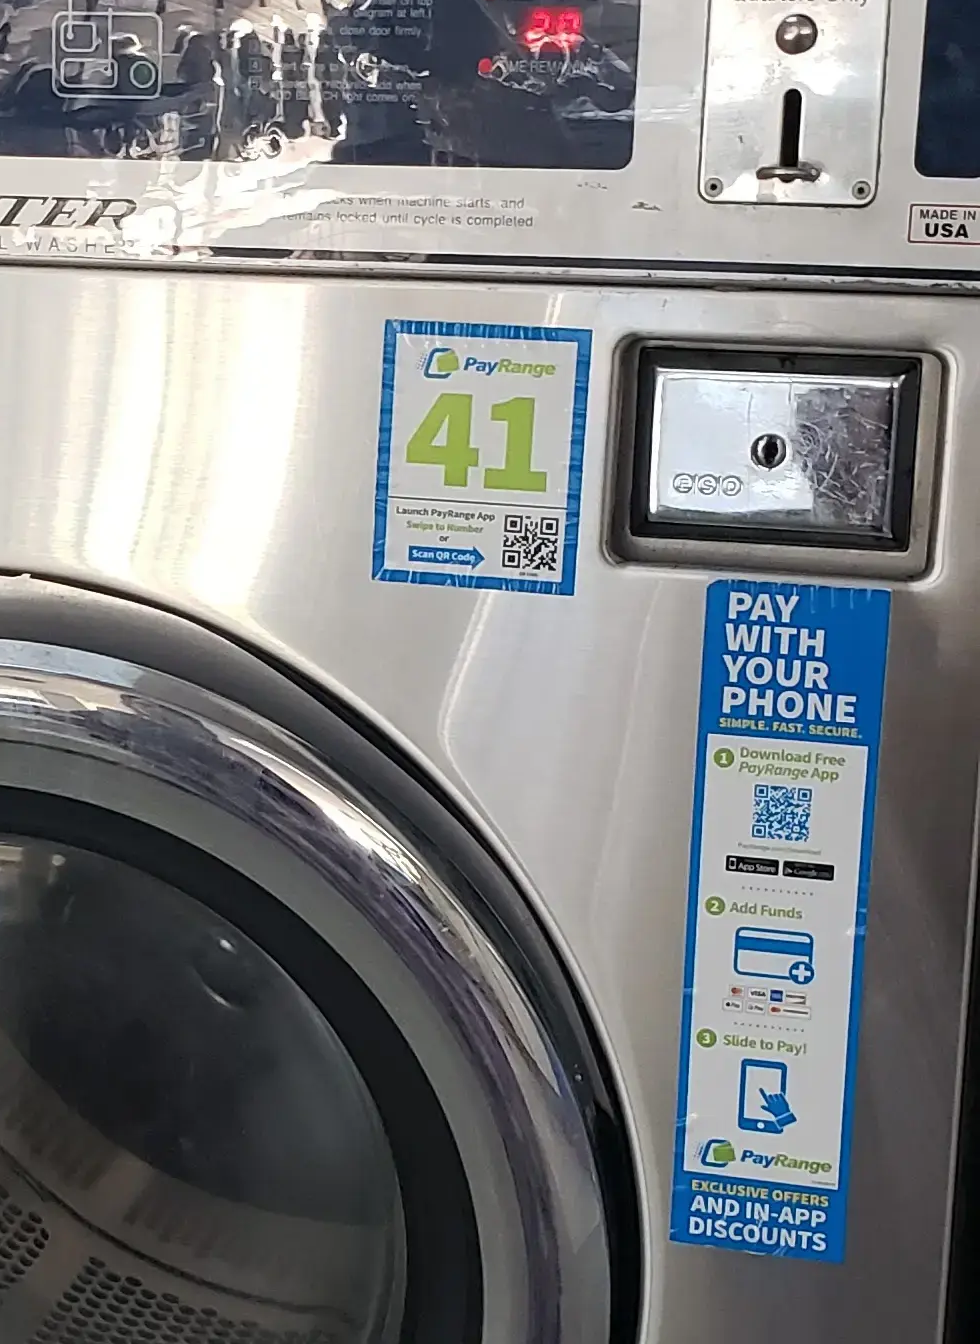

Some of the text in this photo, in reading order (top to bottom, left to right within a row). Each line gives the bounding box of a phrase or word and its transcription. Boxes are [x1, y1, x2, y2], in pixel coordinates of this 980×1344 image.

[358, 197, 392, 206] when
[397, 197, 451, 208] machine
[500, 198, 525, 209] and
[382, 212, 409, 224] until
[413, 213, 446, 226] cycle
[451, 215, 462, 225] is
[919, 208, 977, 221] MADE IN
[924, 222, 969, 238] USA
[463, 356, 556, 378] PayRange
[406, 392, 548, 493] 41
[396, 506, 496, 522] Launch PayRange App
[406, 520, 484, 534] Swipe to Number
[439, 535, 449, 543] or
[412, 549, 475, 563] Scan QR Code
[728, 591, 799, 623] PAY
[725, 623, 825, 657] WITH
[722, 654, 829, 690] YOUR
[722, 686, 857, 723] PHONE
[719, 717, 862, 738] SIMPLE. FAST. SECURE.
[720, 747, 846, 766] 1 Download Free
[739, 761, 839, 783] PayRange App
[738, 862, 776, 874] App Store
[710, 900, 803, 919] 2 Add Funds
[702, 1032, 807, 1056] 3 Slide to Pay!
[740, 1150, 832, 1174] PayRange
[691, 1179, 829, 1207] EXCLUSIVE OFFERS
[690, 1195, 827, 1227] AND IN-APP
[689, 1216, 827, 1252] DISCOUNTS
